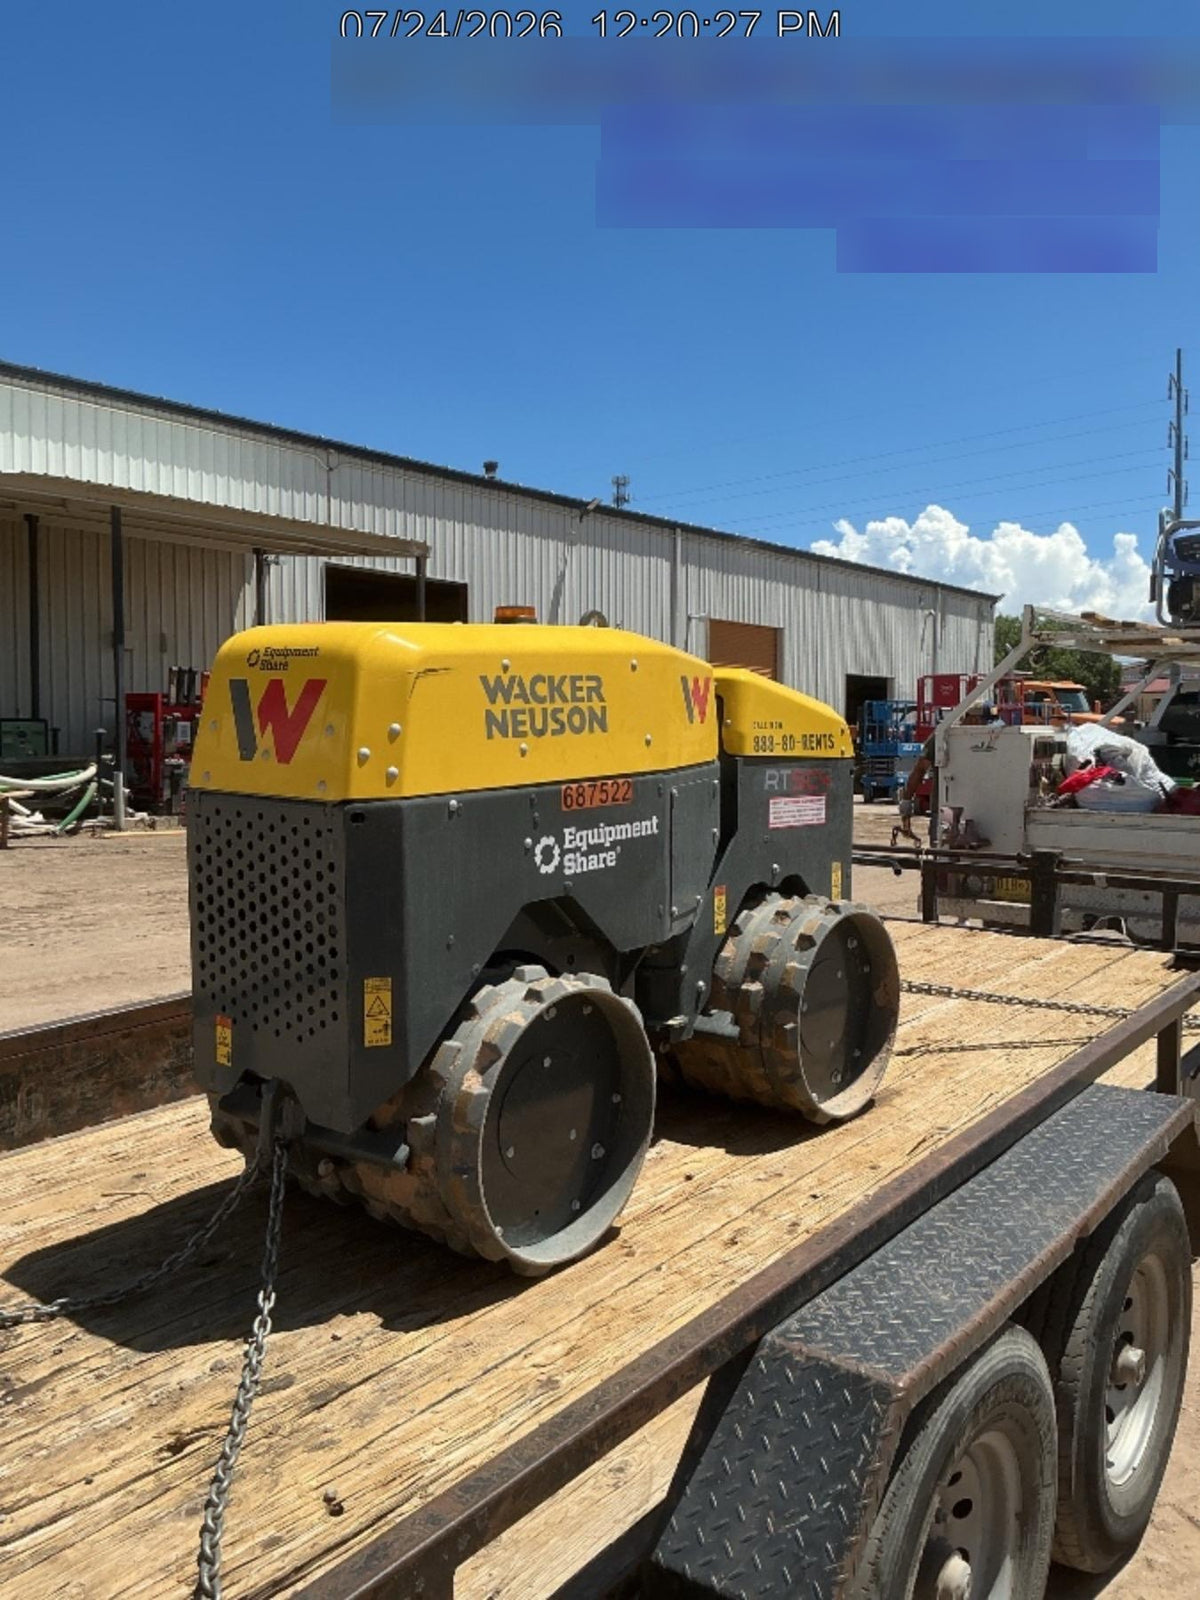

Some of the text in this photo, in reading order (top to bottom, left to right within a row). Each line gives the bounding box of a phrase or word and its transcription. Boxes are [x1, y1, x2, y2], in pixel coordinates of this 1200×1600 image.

[260, 659, 289, 671] Share
[263, 646, 319, 659] Equipment
[479, 674, 606, 704] WACKER
[484, 706, 608, 740] NEUSON
[563, 780, 632, 809] 687522
[563, 815, 659, 851] Equipment
